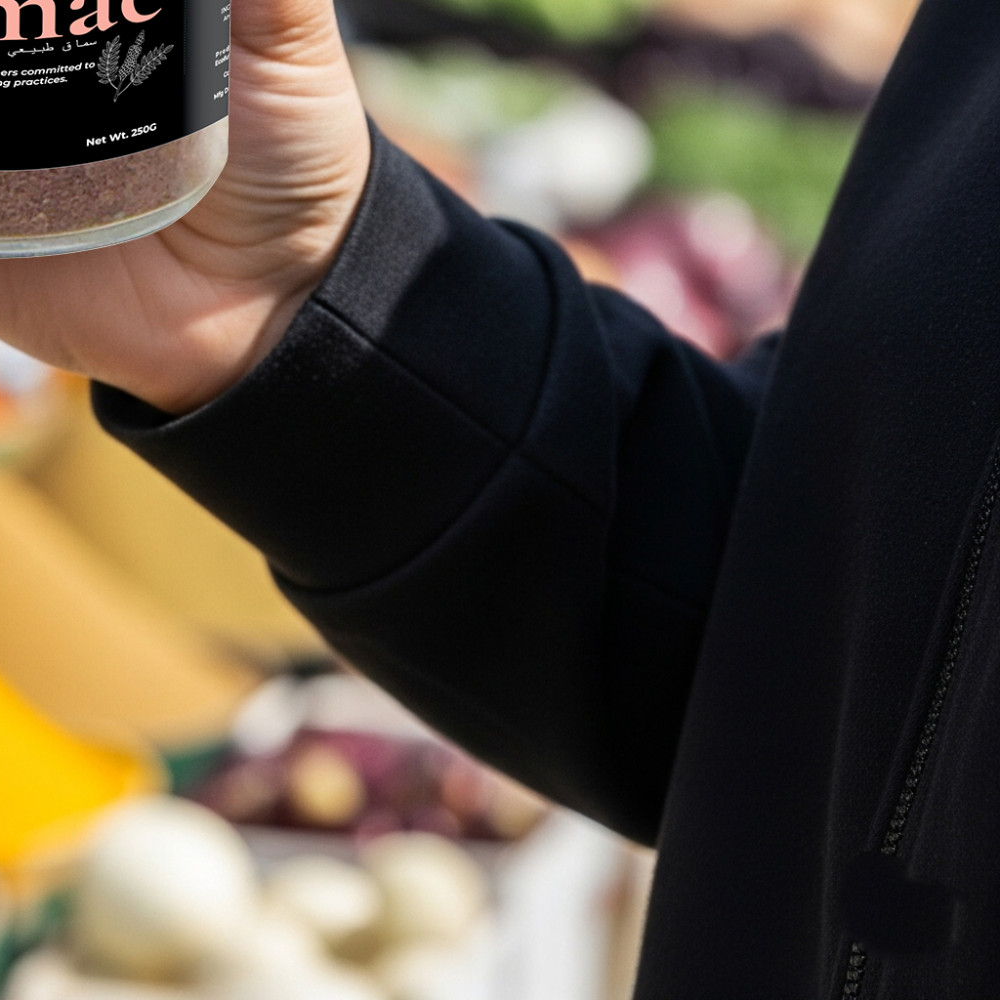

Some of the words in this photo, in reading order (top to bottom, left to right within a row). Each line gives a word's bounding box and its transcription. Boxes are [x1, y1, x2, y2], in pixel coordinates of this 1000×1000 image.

[20, 62, 82, 76] committed
[13, 76, 68, 88] practices.
[86, 136, 107, 147] Net
[109, 131, 129, 142] Wt.
[131, 123, 158, 138] 250G
